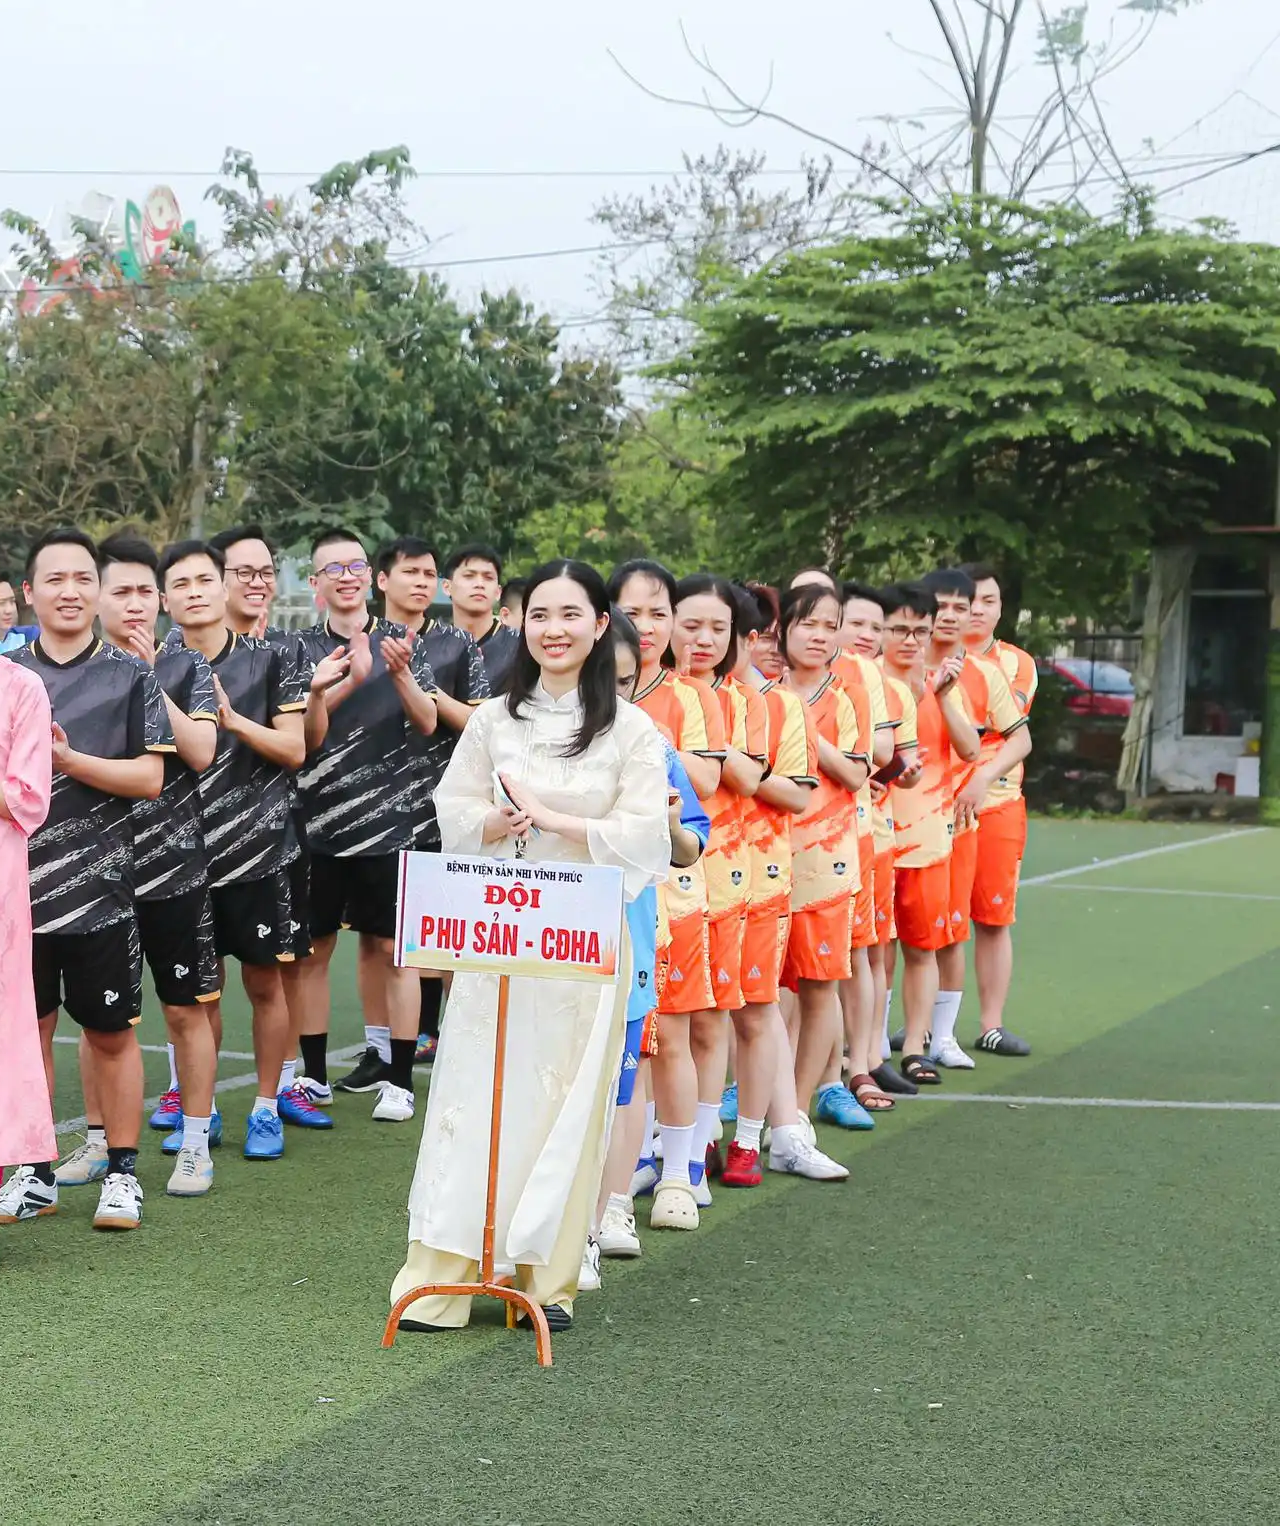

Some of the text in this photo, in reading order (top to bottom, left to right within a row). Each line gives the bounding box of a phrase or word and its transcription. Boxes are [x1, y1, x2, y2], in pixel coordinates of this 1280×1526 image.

[446, 860, 470, 875] BỆNH
[472, 863, 493, 878] VIỆN
[515, 868, 532, 879] NHI
[534, 867, 556, 881] VĨNH
[558, 870, 583, 883] PHÚC
[484, 881, 542, 912] ĐỘI
[420, 915, 466, 959] PHỤ
[472, 911, 519, 957] SẢN
[540, 927, 601, 964] CĐHA
